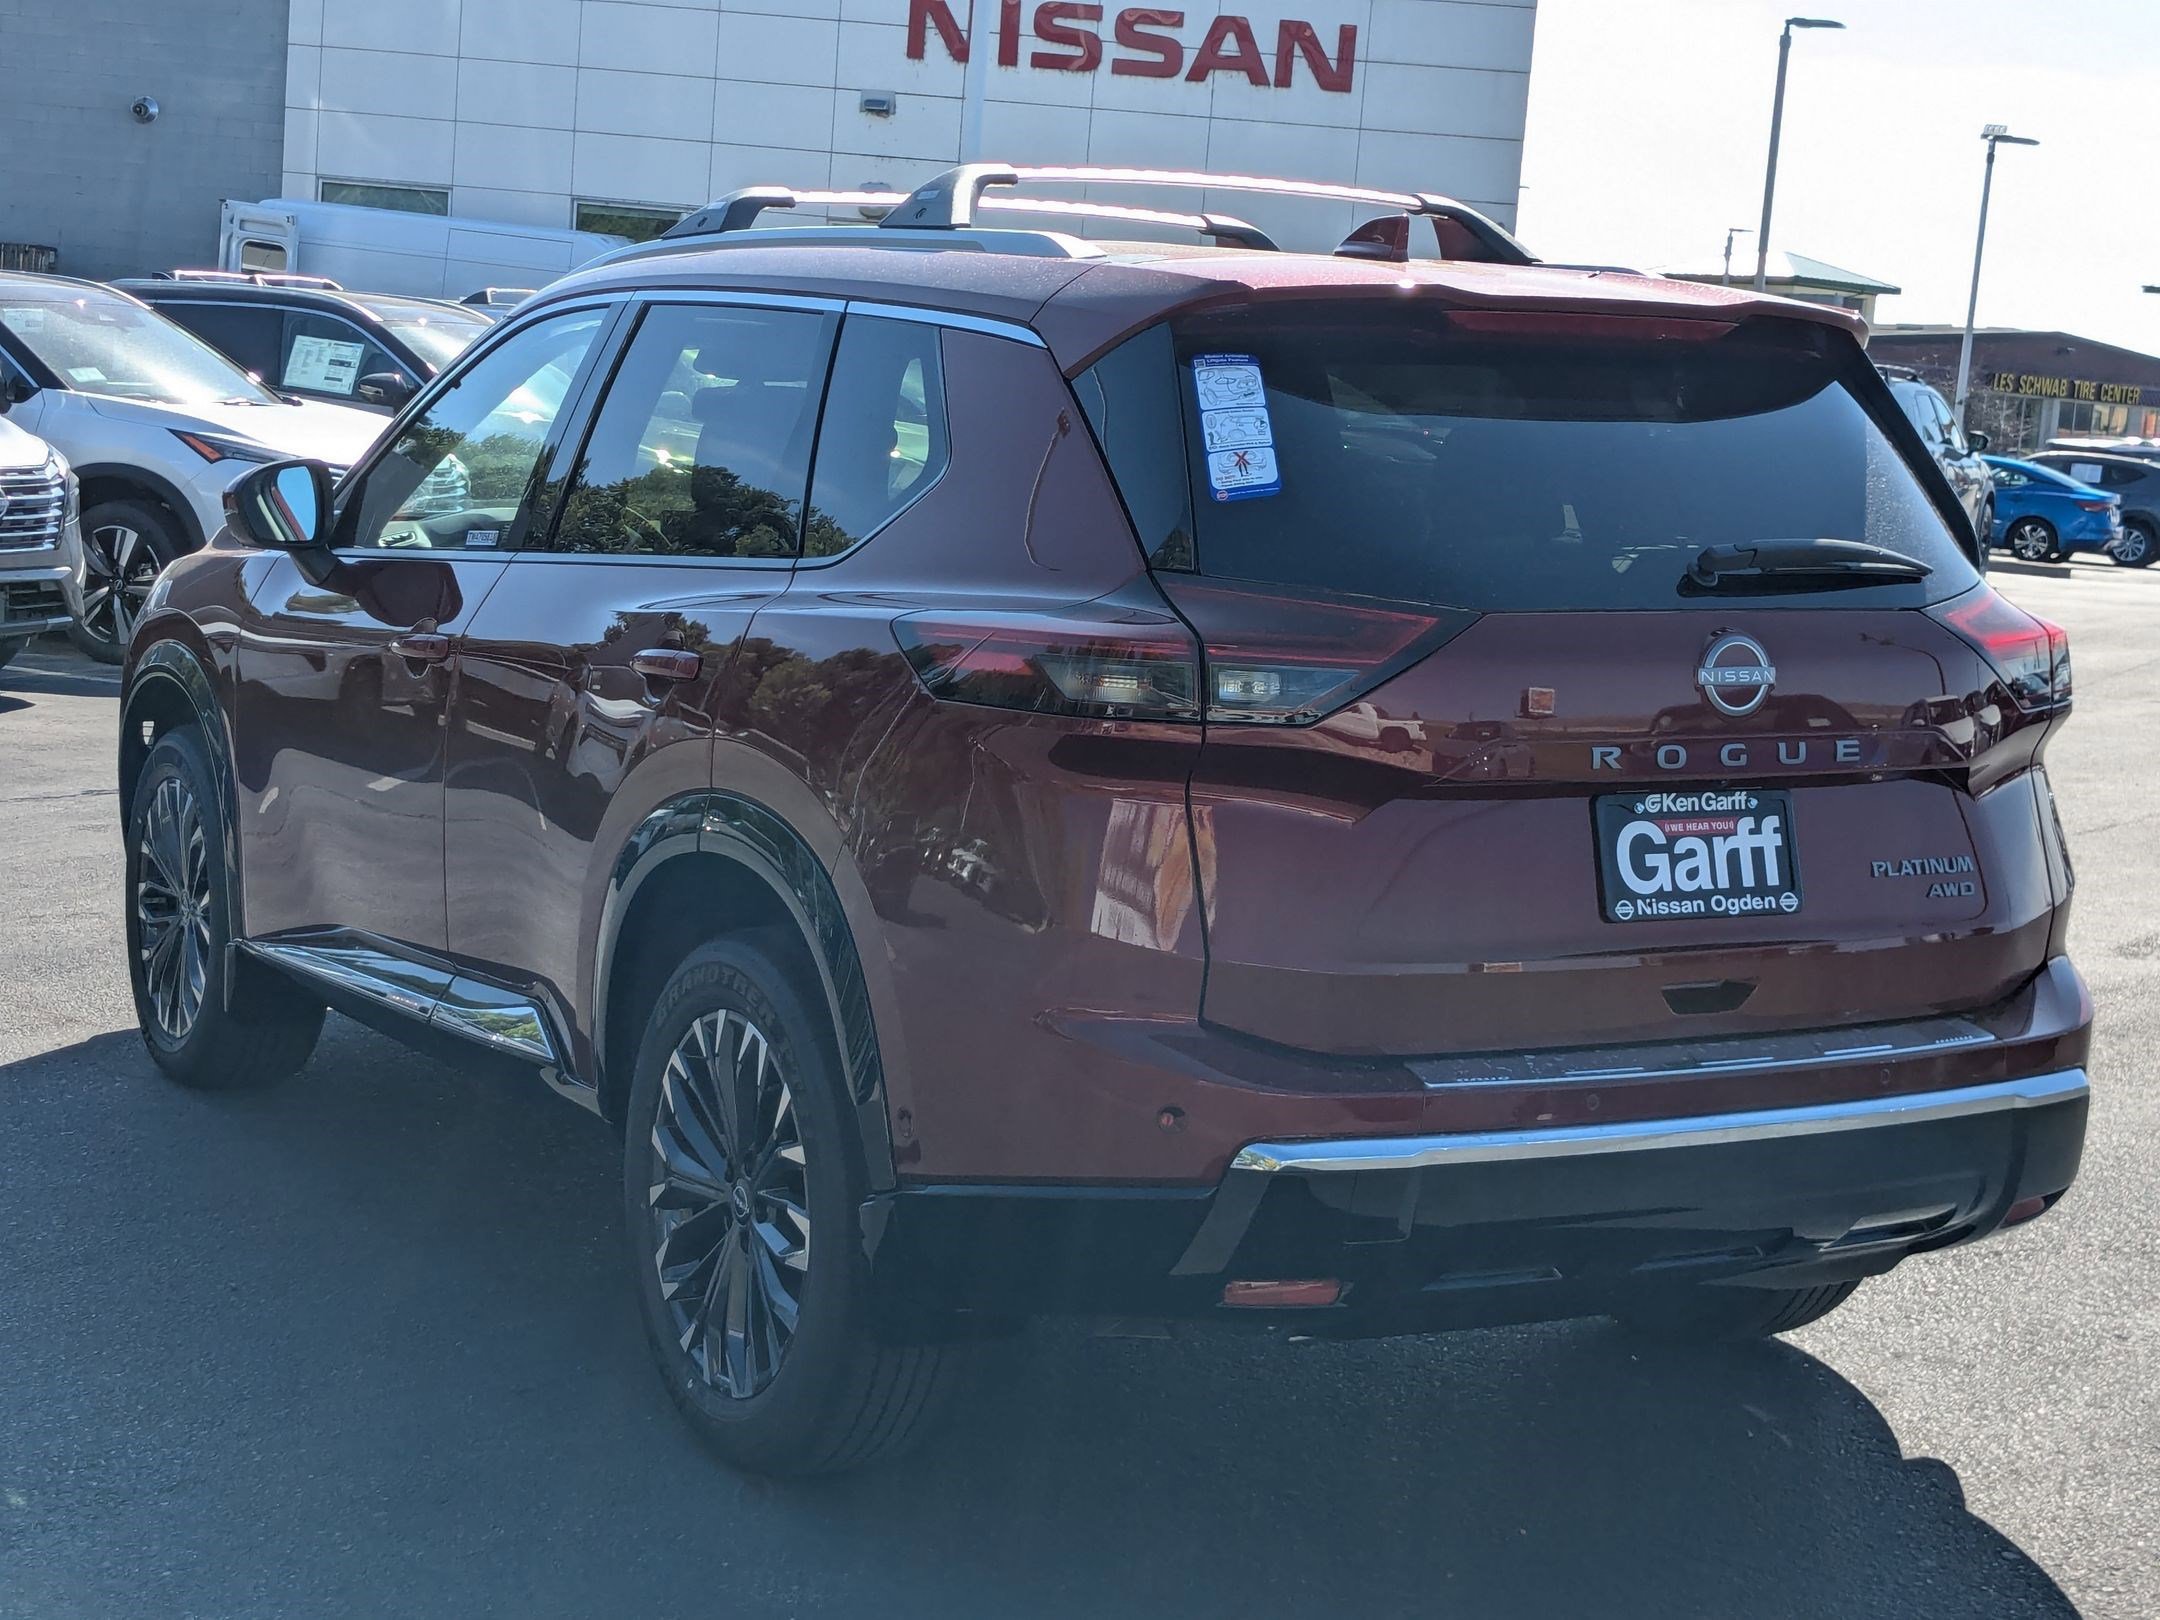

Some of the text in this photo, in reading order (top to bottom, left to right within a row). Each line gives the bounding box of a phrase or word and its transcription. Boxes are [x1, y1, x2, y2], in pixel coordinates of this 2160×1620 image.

[906, 0, 1358, 93] NISSAN
[1993, 373, 2141, 404] LES SCHWAB TIRE CENTER
[1701, 669, 1775, 684] NISSAN
[1591, 739, 1861, 770] ROGUE
[1662, 791, 1747, 812] Ken Garff
[1670, 821, 1730, 832] WE HEAR YOU
[1616, 815, 1782, 895] Garff
[1870, 856, 1974, 878] PLATINUM
[1927, 881, 1976, 898] AWD
[1636, 894, 1776, 916] Nissan Ogden
